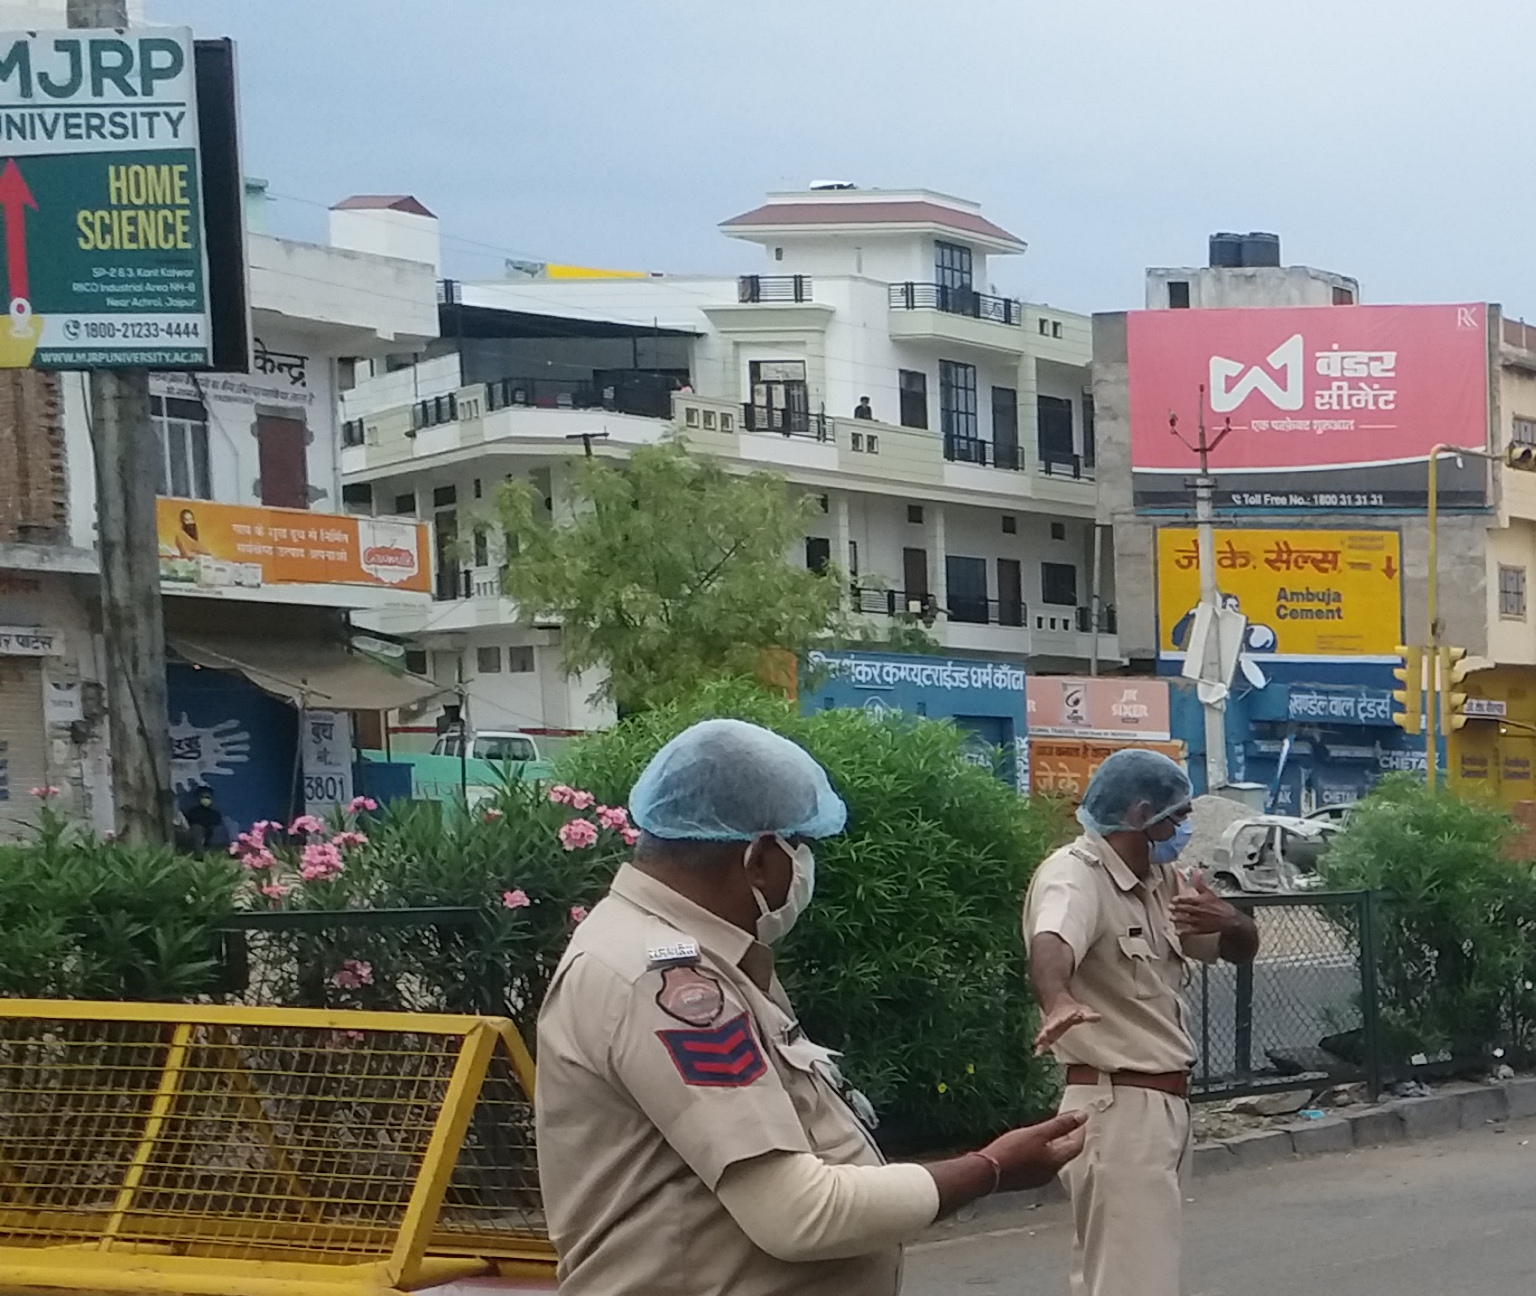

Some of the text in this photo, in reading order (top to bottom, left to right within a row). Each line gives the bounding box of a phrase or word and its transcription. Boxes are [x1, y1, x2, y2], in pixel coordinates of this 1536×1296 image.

[0, 111, 186, 141] NIVERSITY
[108, 164, 191, 205] HOME
[77, 208, 192, 250] SCIENCE
[84, 322, 199, 339] 1800-21233-4444
[41, 351, 204, 364] WWW.MJRPUNIVERSITY.AC.IN
[1315, 343, 1397, 378] वंडर
[1315, 381, 1397, 411] सीमेंट
[1243, 494, 1262, 505] Toll
[1263, 494, 1287, 505] Free
[1312, 494, 1337, 505] 1800
[1339, 494, 1353, 505] 31
[1355, 494, 1368, 505] 31
[1370, 494, 1383, 505] 31
[1276, 587, 1343, 606] Ambuja
[1276, 605, 1343, 620] Cement
